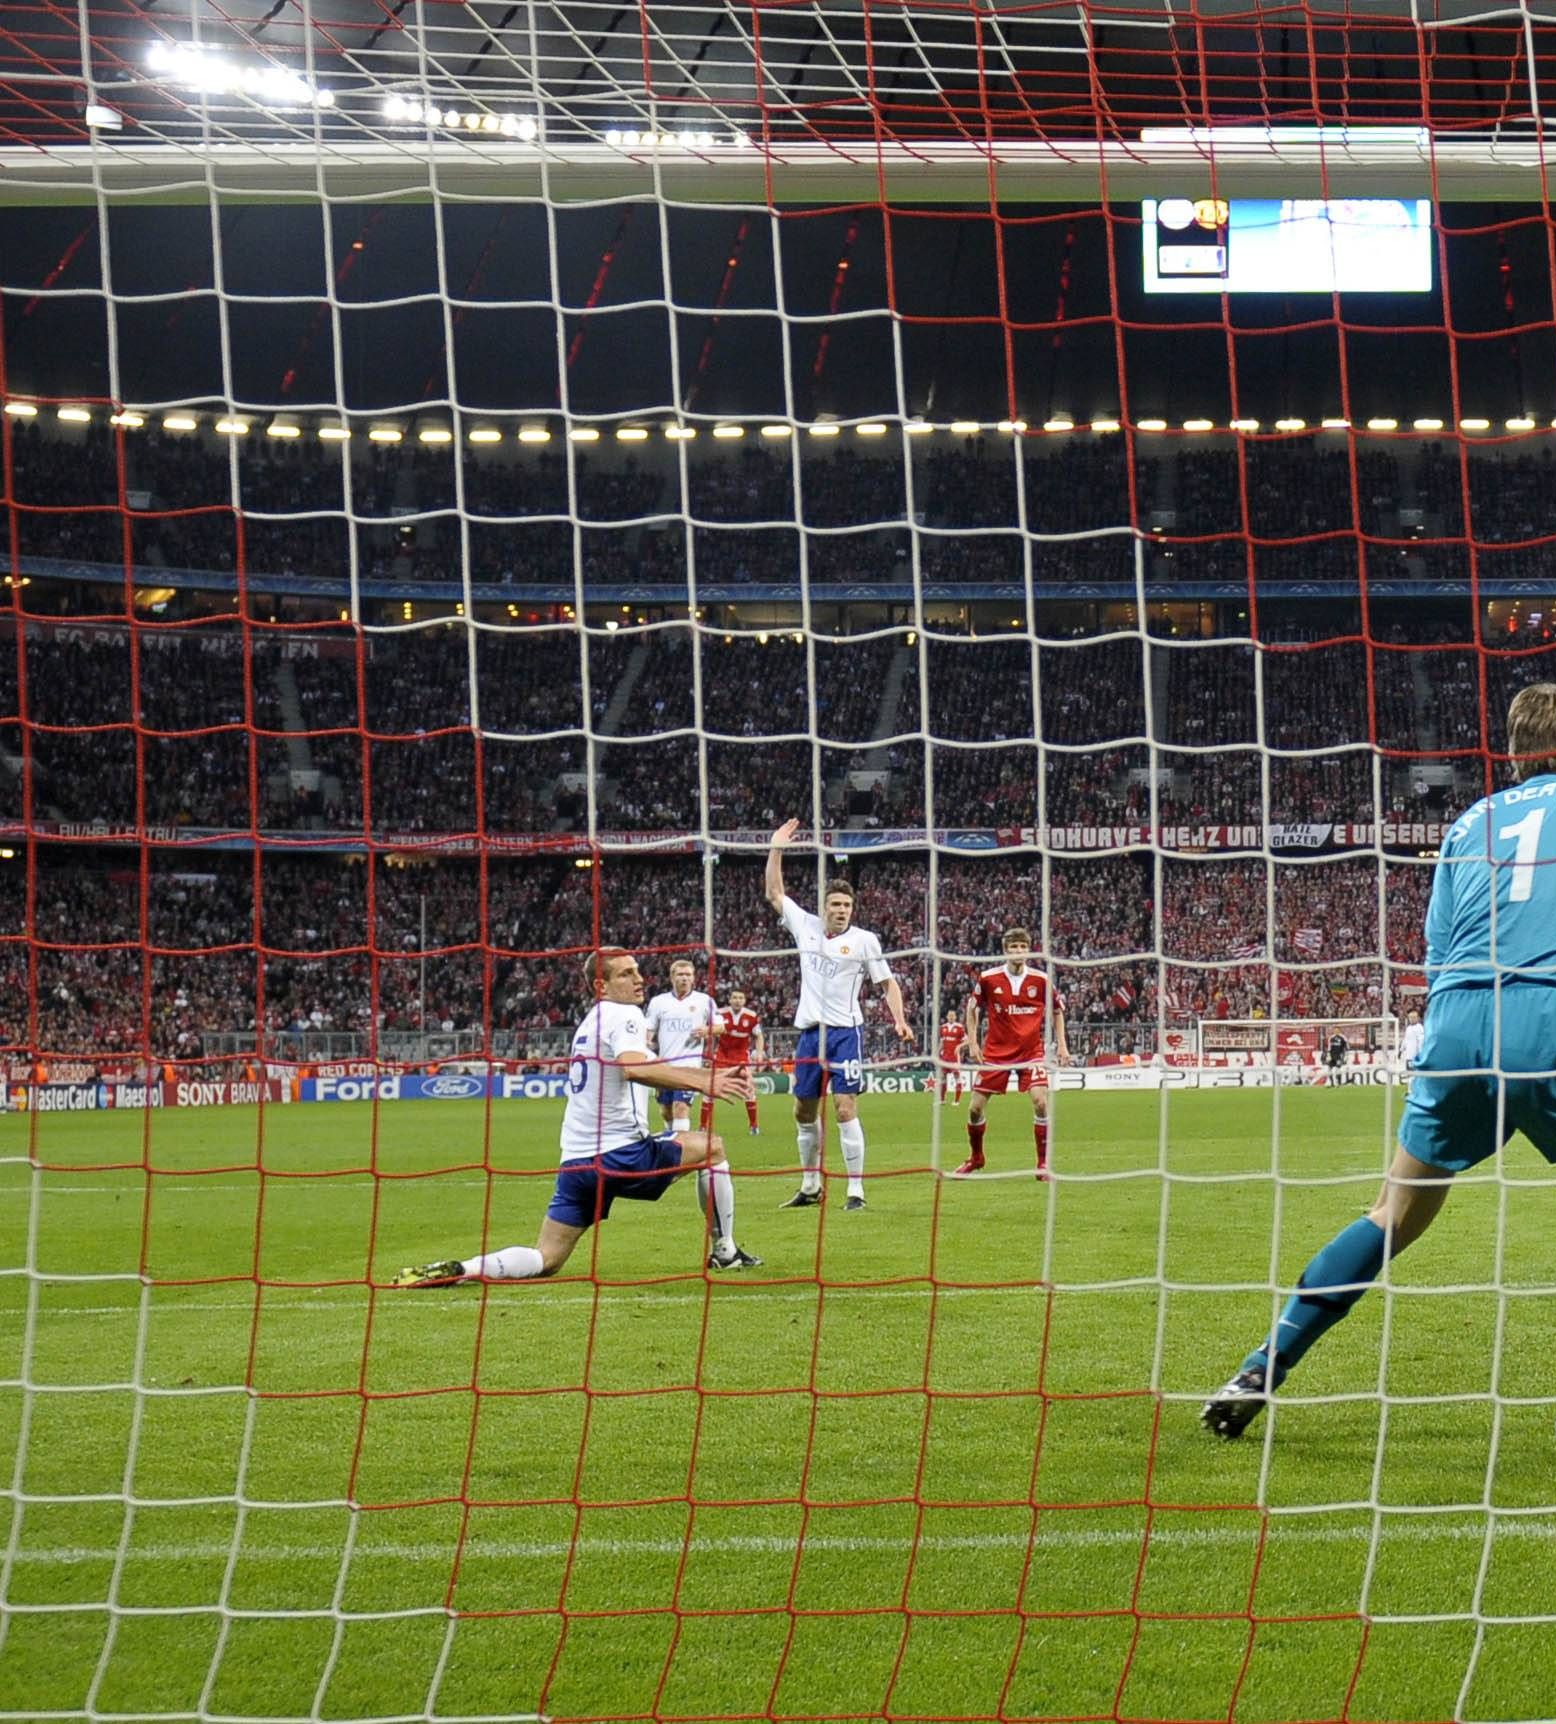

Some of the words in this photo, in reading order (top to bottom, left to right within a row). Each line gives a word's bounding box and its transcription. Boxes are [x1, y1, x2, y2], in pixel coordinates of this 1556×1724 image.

[1451, 800, 1496, 842] VAN
[1272, 834, 1318, 847] GLAZER
[1499, 808, 1546, 902] 1
[810, 957, 837, 978] AIG
[844, 1059, 860, 1080] 16
[1031, 1067, 1047, 1080] 25
[1105, 1073, 1140, 1081] SONY
[177, 1083, 226, 1107] SONY
[230, 1081, 272, 1105] BRAVA
[315, 1077, 399, 1101] Ford
[432, 1078, 470, 1095] Ford
